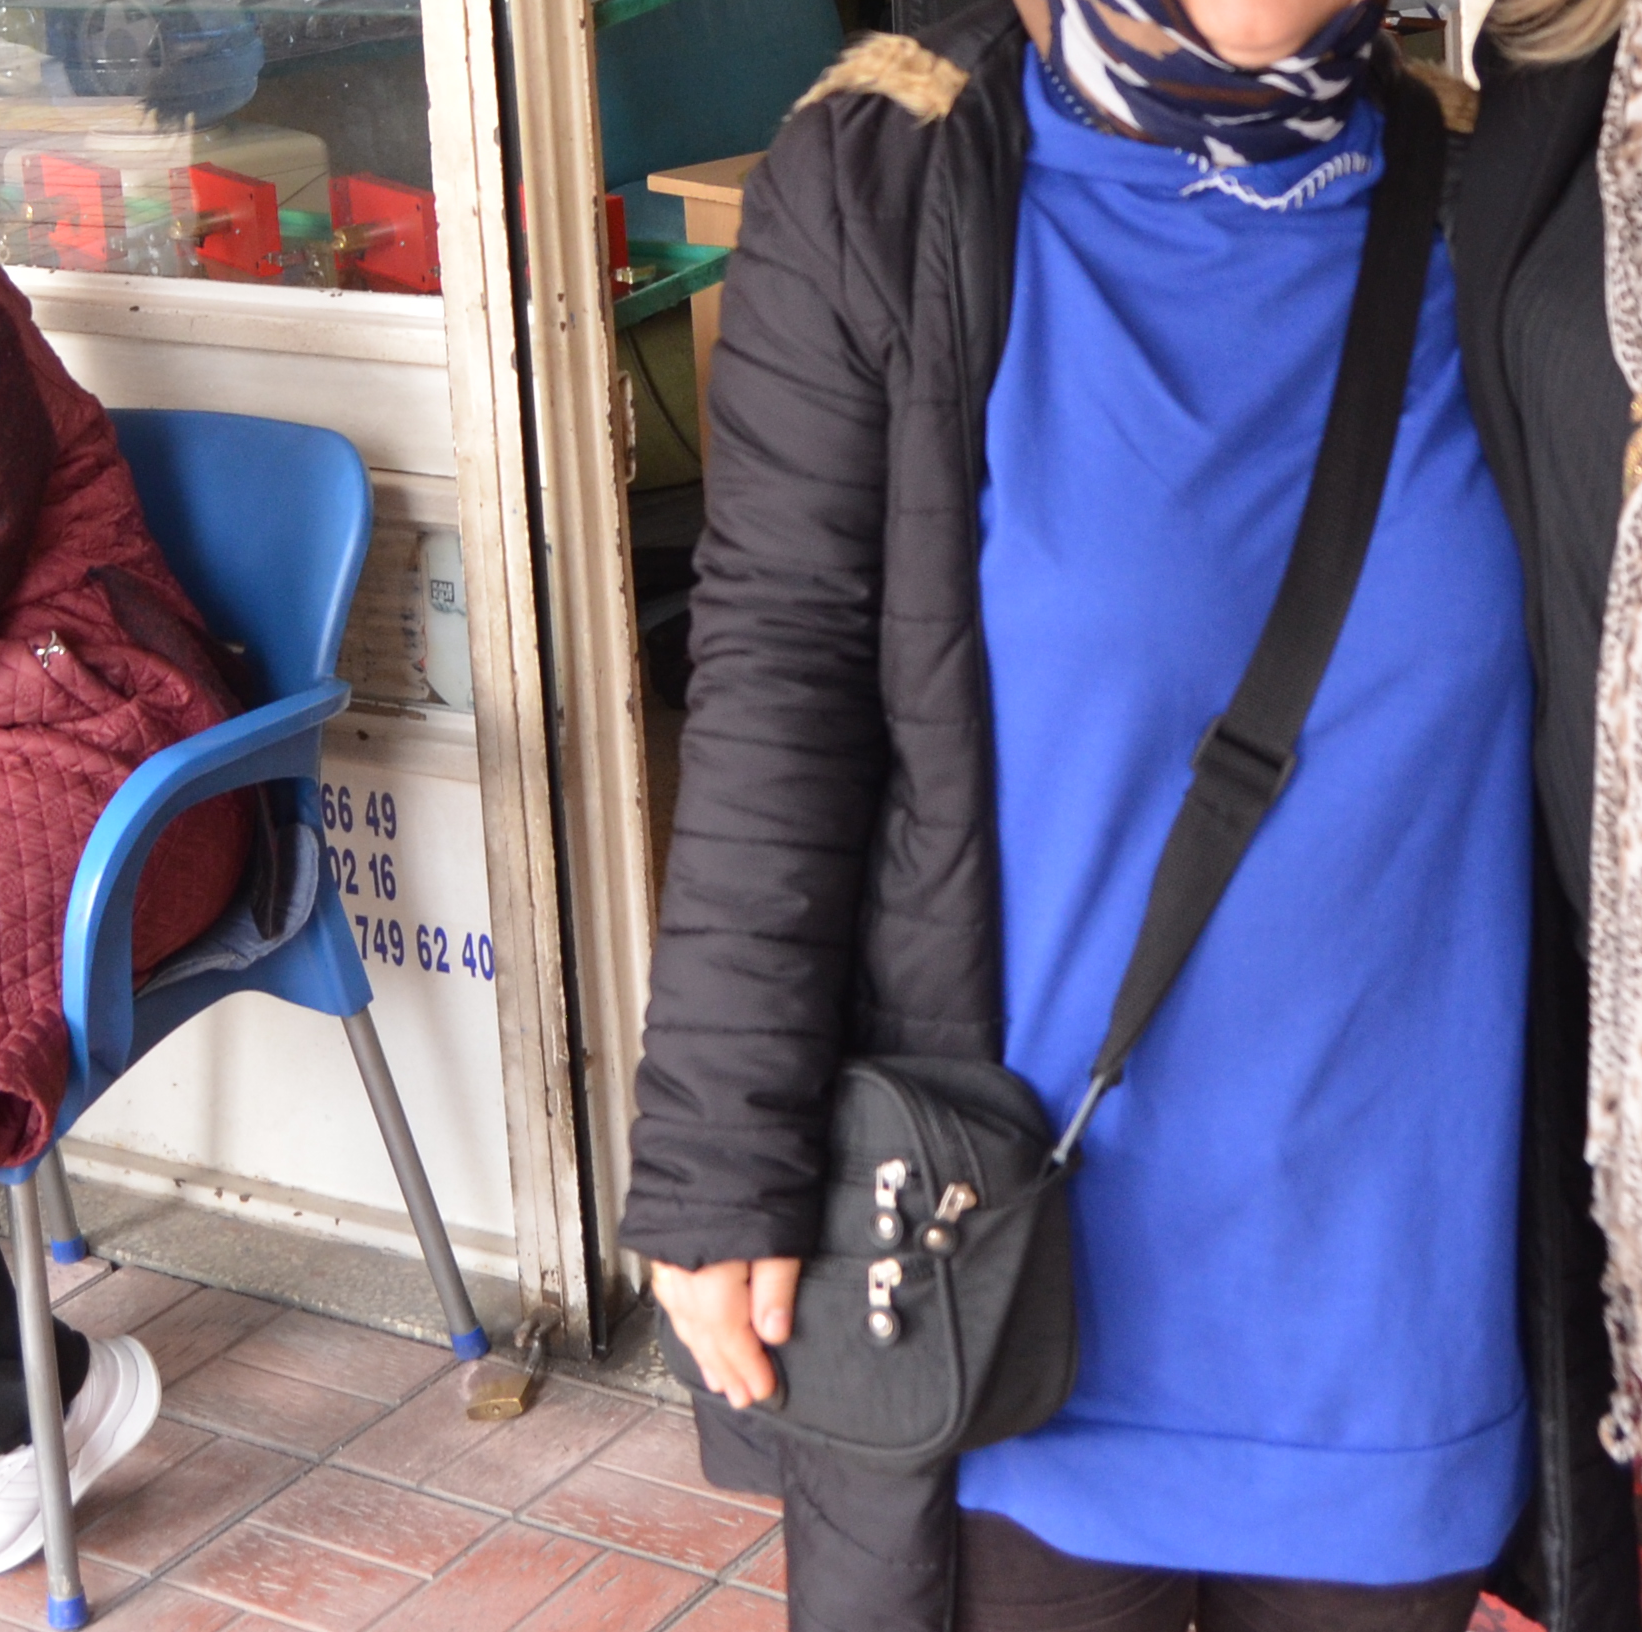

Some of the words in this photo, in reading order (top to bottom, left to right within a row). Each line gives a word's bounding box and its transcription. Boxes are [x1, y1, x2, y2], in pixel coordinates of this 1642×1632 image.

[320, 783, 353, 833] 66
[365, 790, 397, 840] 49
[368, 853, 397, 901] 16
[354, 915, 405, 967] 749
[416, 924, 451, 974] 62
[462, 932, 496, 982] 40
